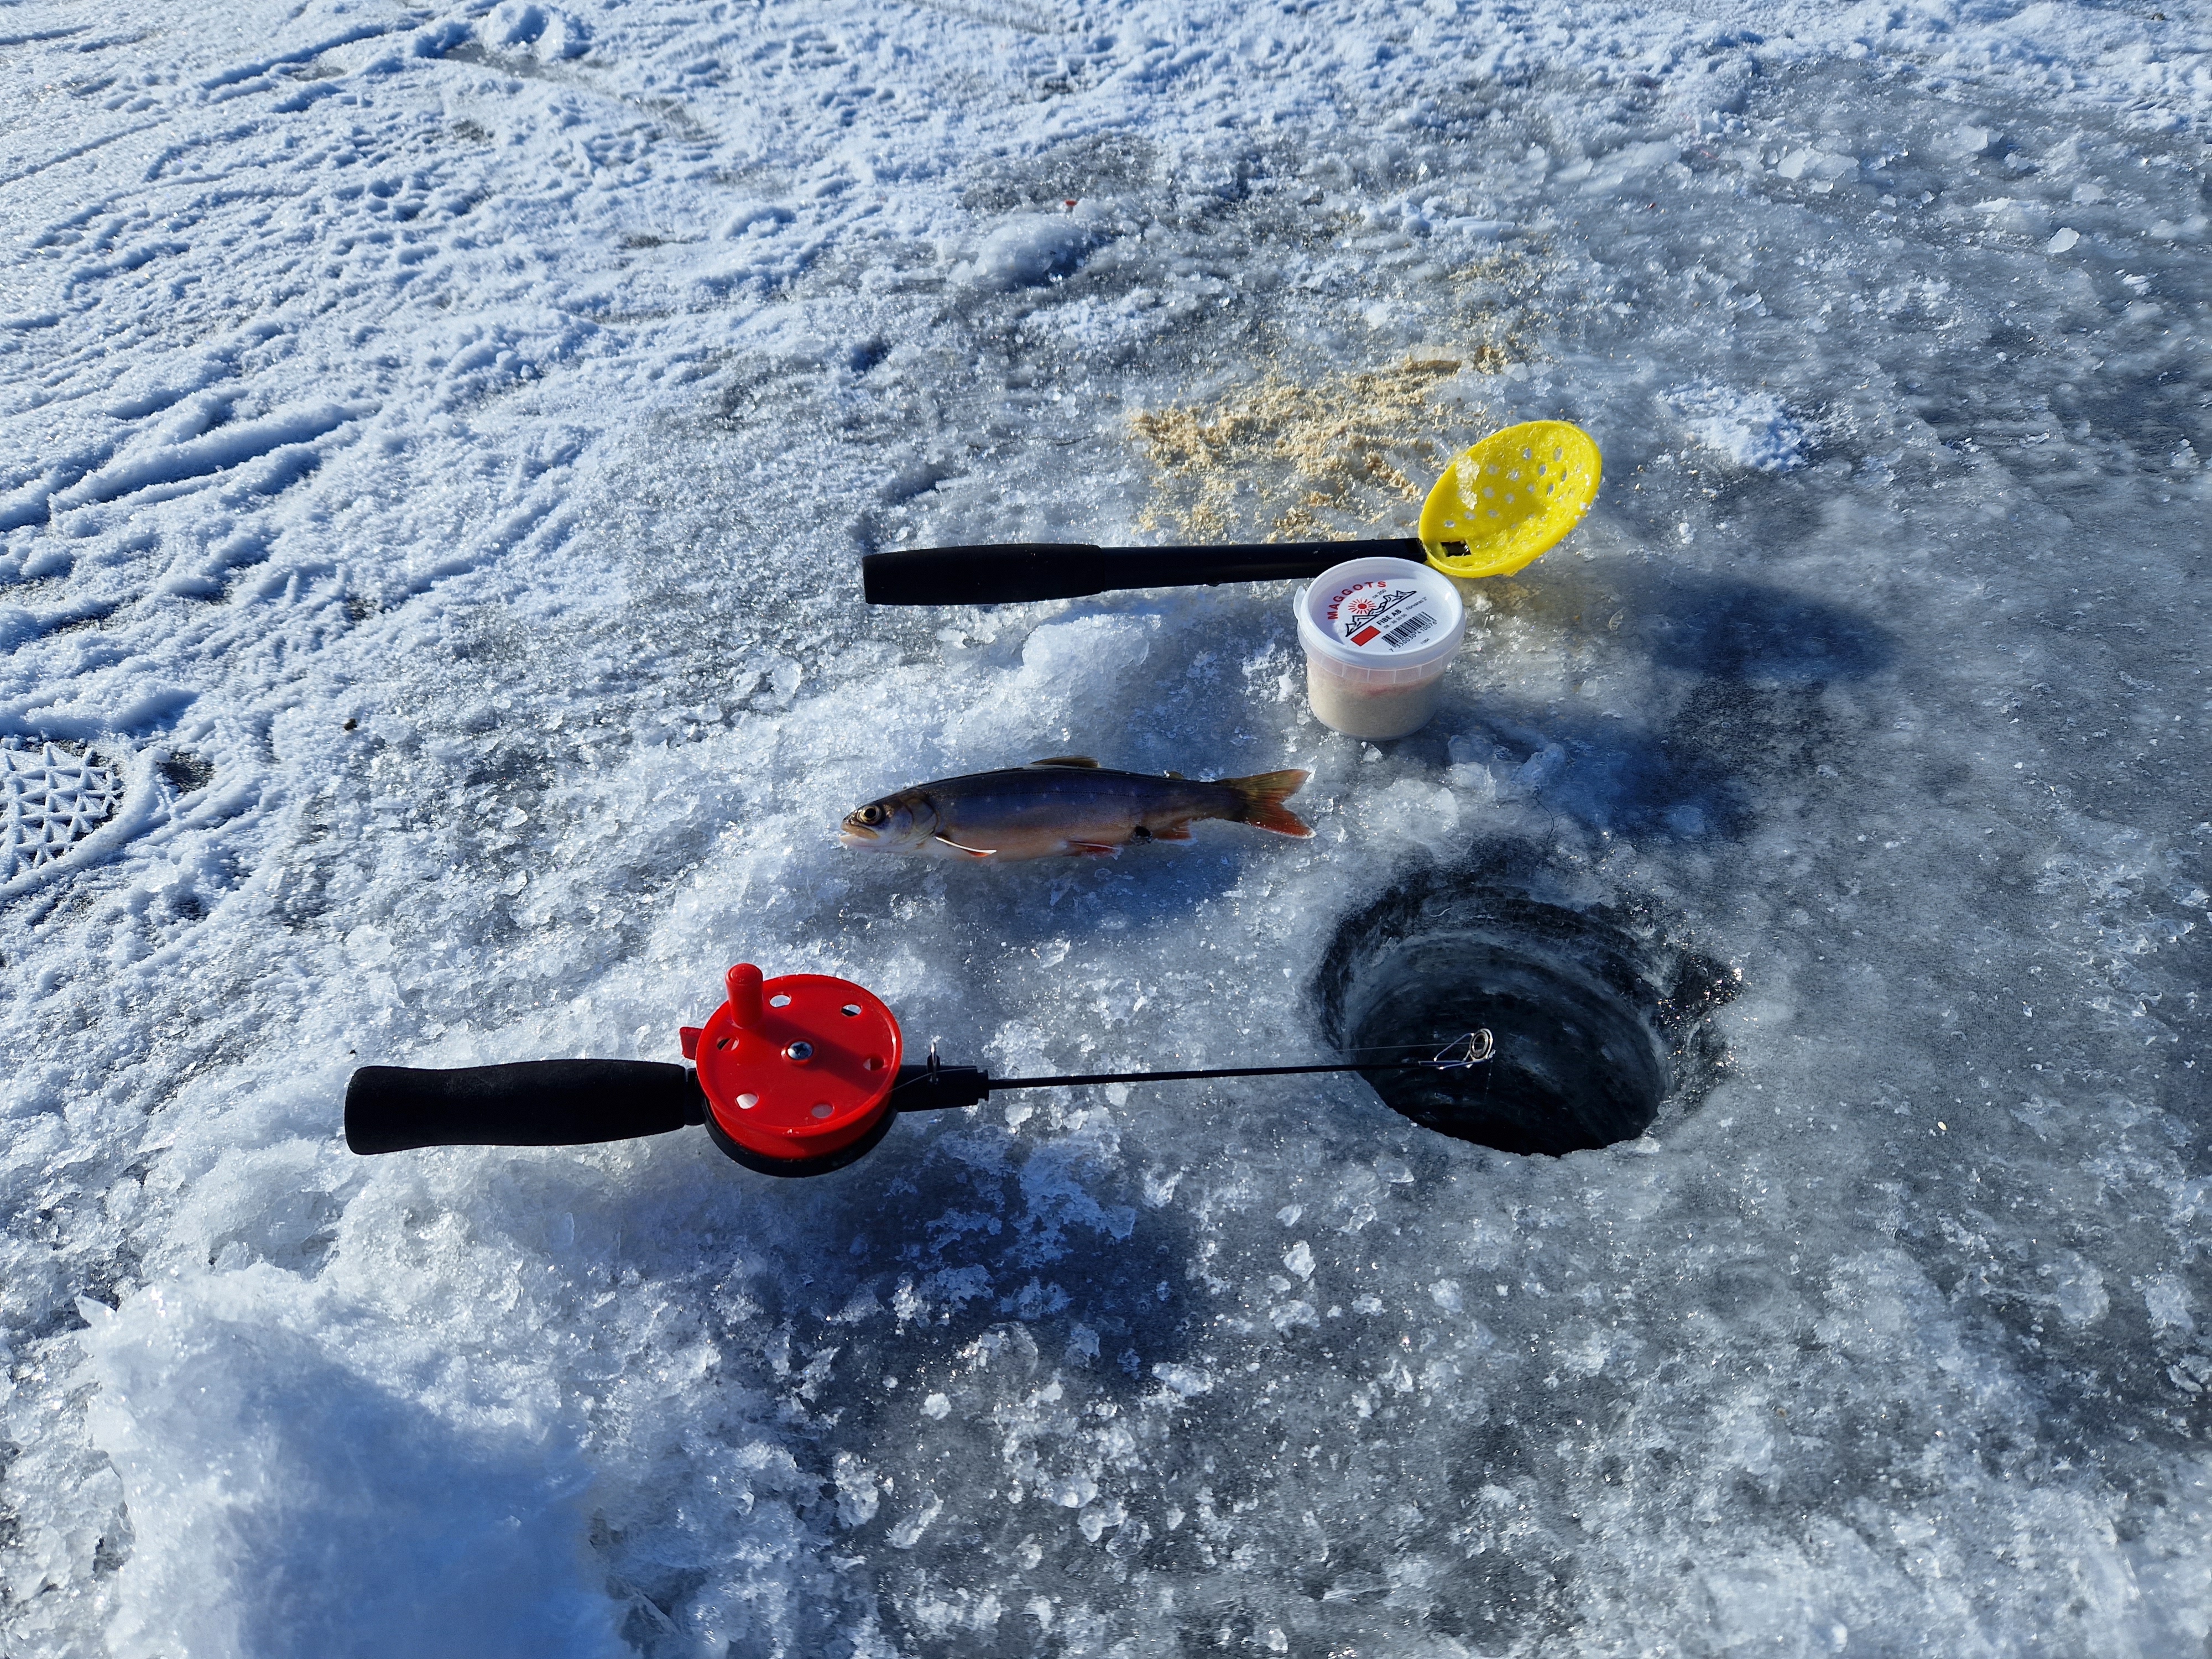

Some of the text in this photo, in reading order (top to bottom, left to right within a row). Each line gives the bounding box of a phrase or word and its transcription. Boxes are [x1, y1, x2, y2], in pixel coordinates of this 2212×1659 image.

[1327, 581, 1387, 620] MAGGOTS
[1376, 615, 1392, 626] FIBE
[1396, 633, 1417, 648] 350030
[1417, 621, 1437, 634] 410076
